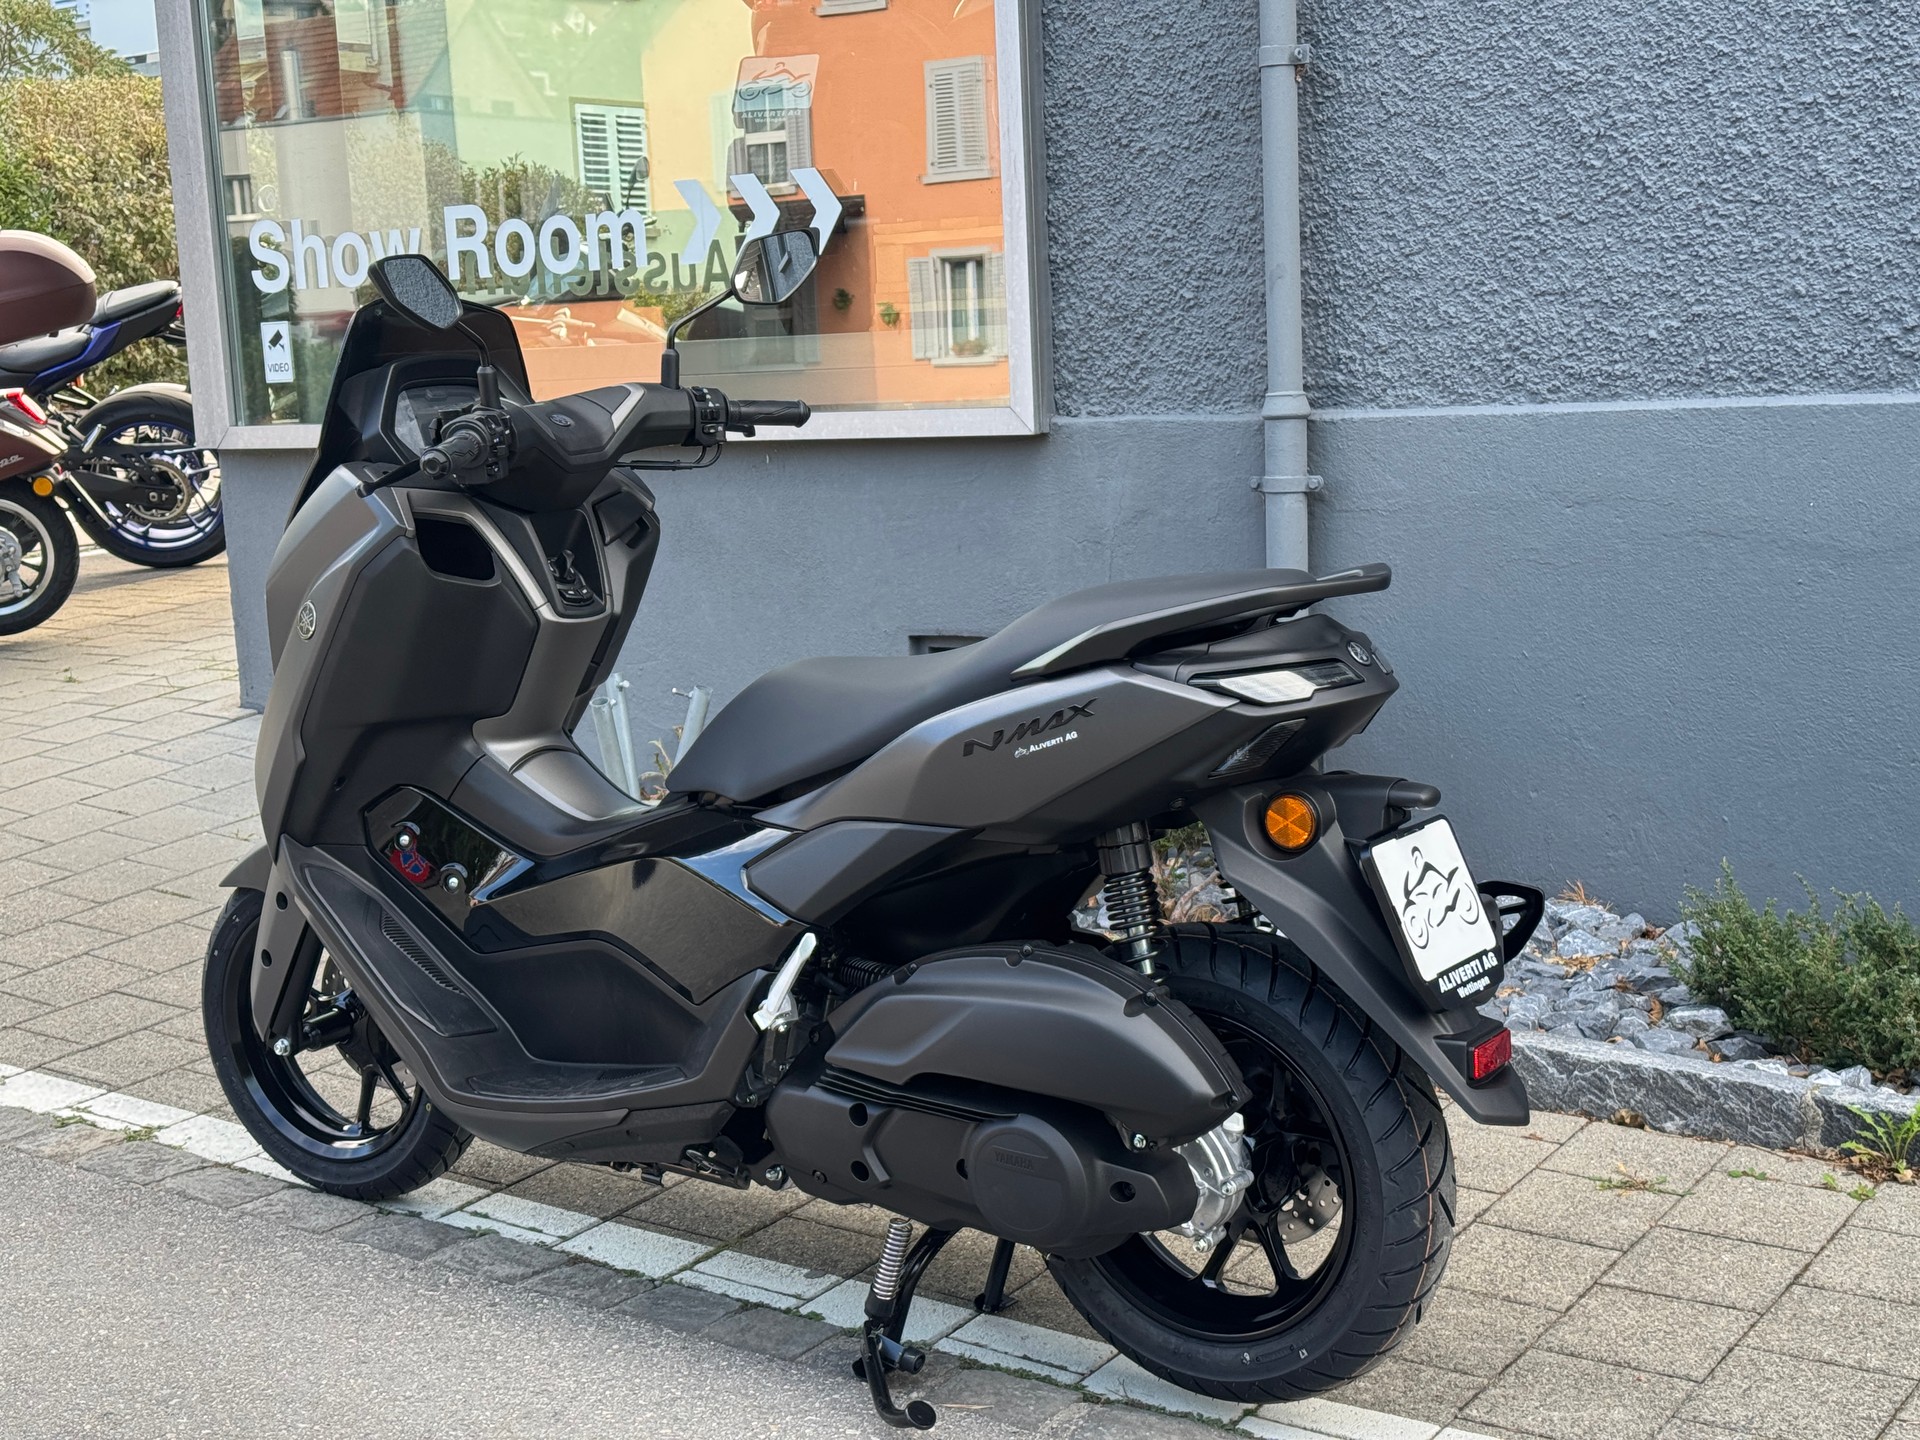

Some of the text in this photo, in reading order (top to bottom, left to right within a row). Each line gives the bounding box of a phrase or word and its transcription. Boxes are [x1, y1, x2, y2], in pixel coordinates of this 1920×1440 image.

[249, 204, 648, 294] Show Room
[267, 362, 290, 373] VIDEO
[963, 697, 1098, 757] NMAX
[1029, 731, 1079, 753] ALIVERTI AG
[1438, 951, 1499, 994] ALIVERTI AG
[1456, 975, 1491, 999] Wettingen
